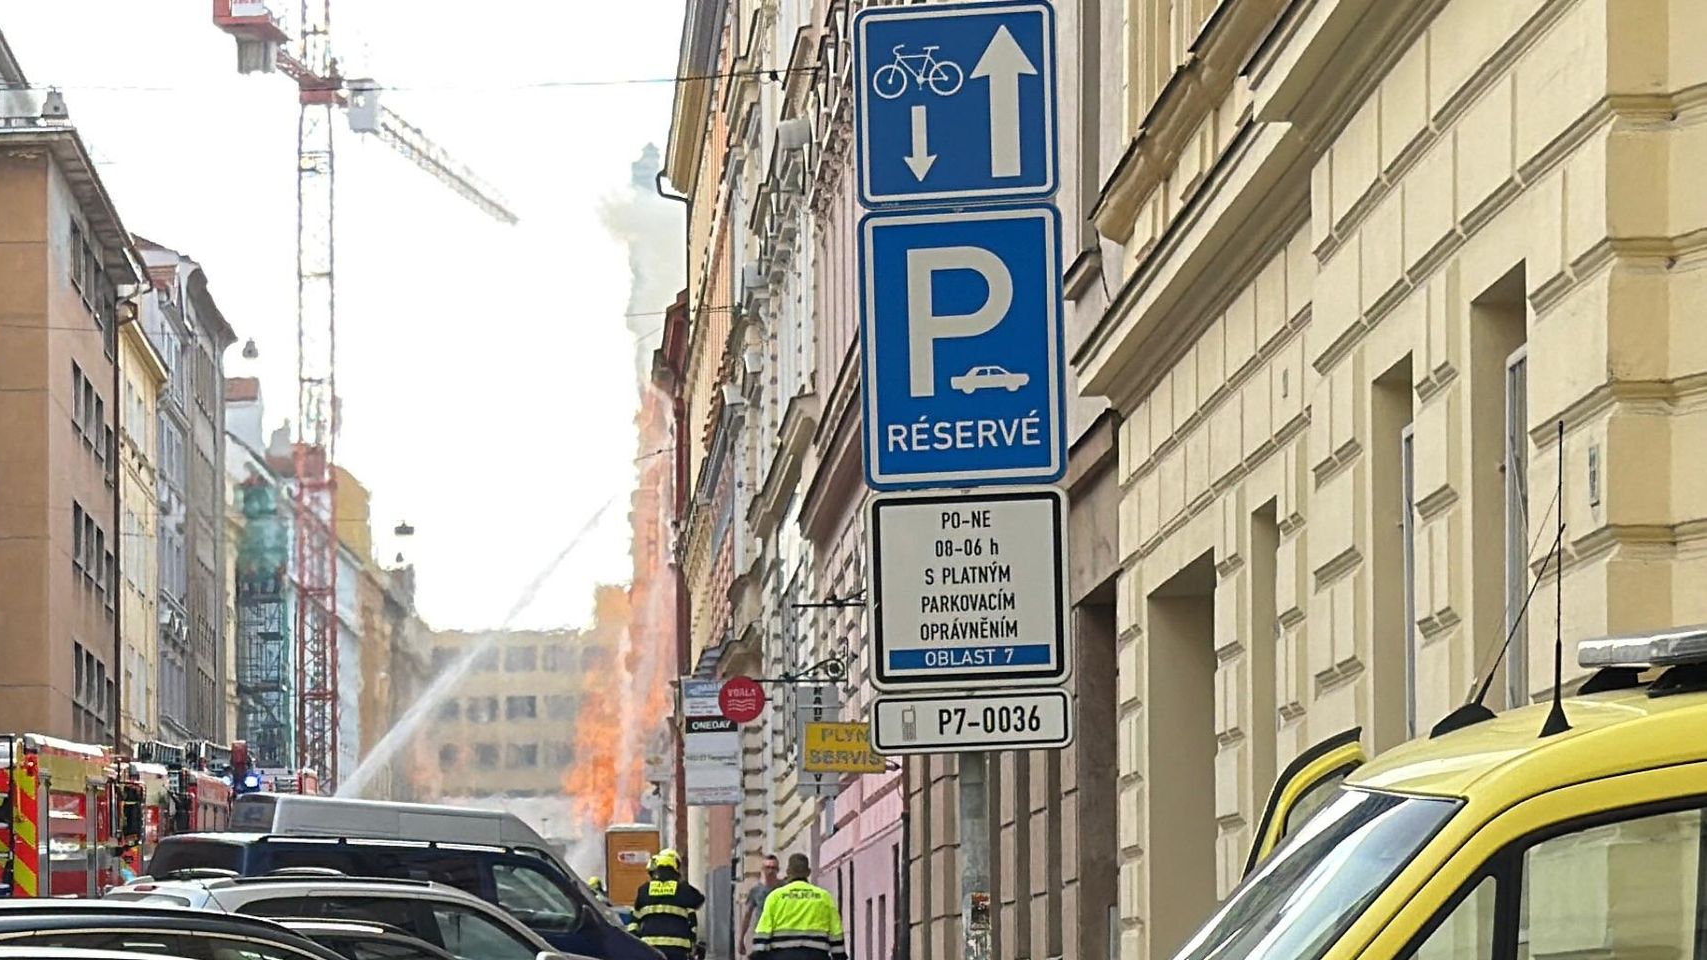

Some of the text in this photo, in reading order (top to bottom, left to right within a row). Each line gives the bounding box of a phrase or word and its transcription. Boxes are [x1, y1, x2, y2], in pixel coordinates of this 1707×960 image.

[906, 246, 1013, 397] P
[888, 409, 1041, 452] RÉSERVÉ
[941, 510, 991, 529] PO-NE
[935, 537, 999, 557] 08-06 h
[925, 561, 1010, 585] S PLATNÝM
[921, 591, 1015, 613] PARKOVACÍM
[920, 615, 1018, 641] OPRÁVNĚNÍM
[924, 647, 1014, 667] OBLAST 7
[691, 720, 731, 730] ONEDAY
[938, 704, 1041, 735] P7-0036
[809, 750, 881, 765] SERVIS
